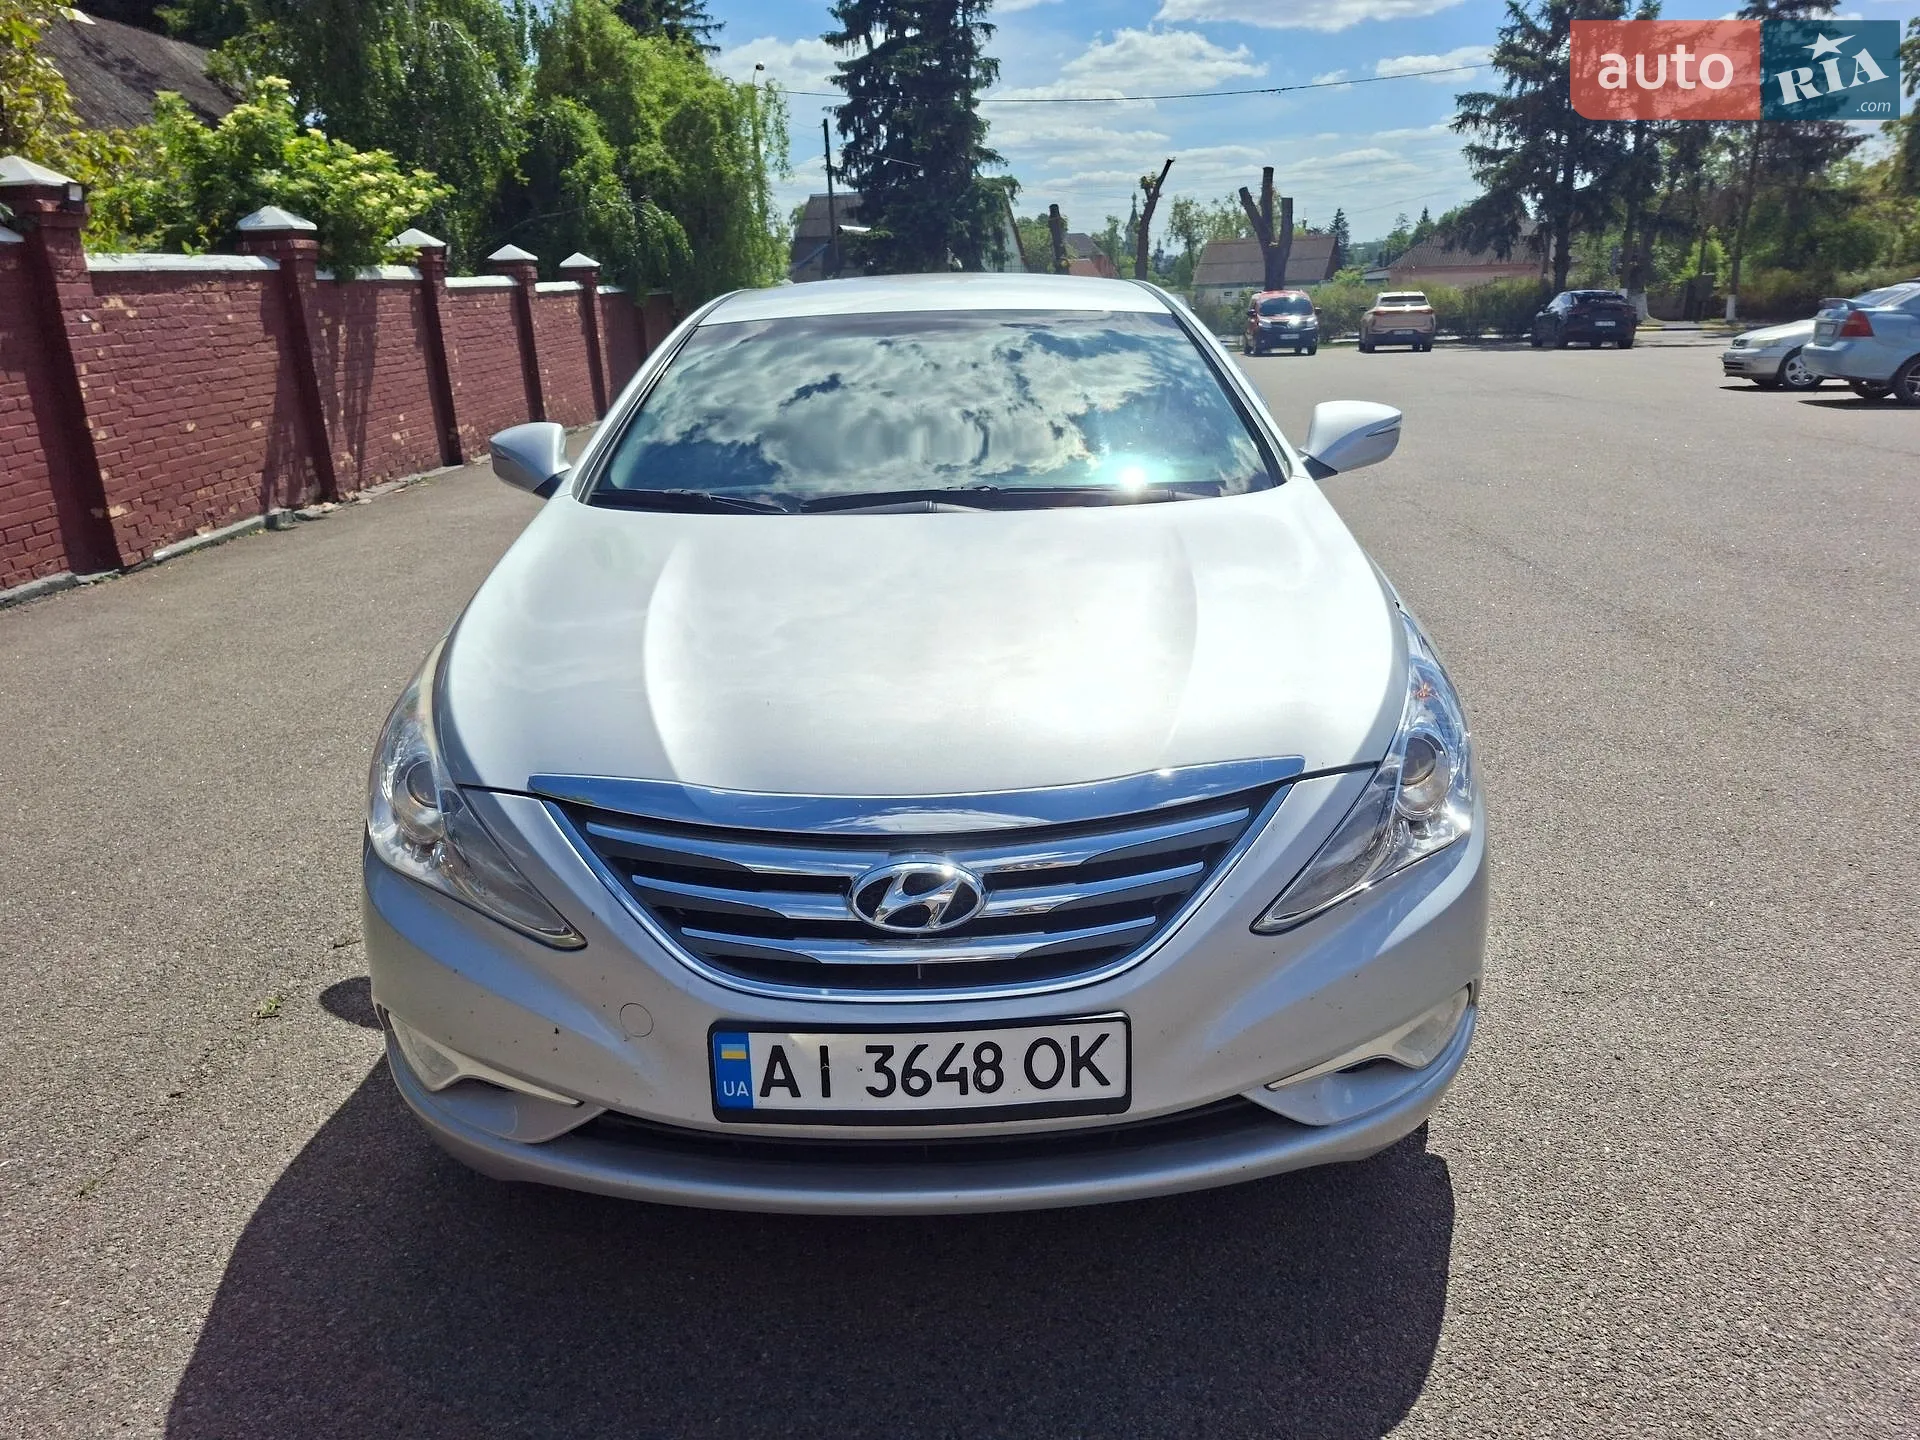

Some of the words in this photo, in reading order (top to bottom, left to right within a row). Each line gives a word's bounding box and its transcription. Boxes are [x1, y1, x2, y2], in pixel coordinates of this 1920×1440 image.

[760, 1045, 831, 1098] AI
[865, 1041, 1004, 1097] 3648
[1024, 1034, 1110, 1089] OK
[723, 1081, 749, 1097] UA
